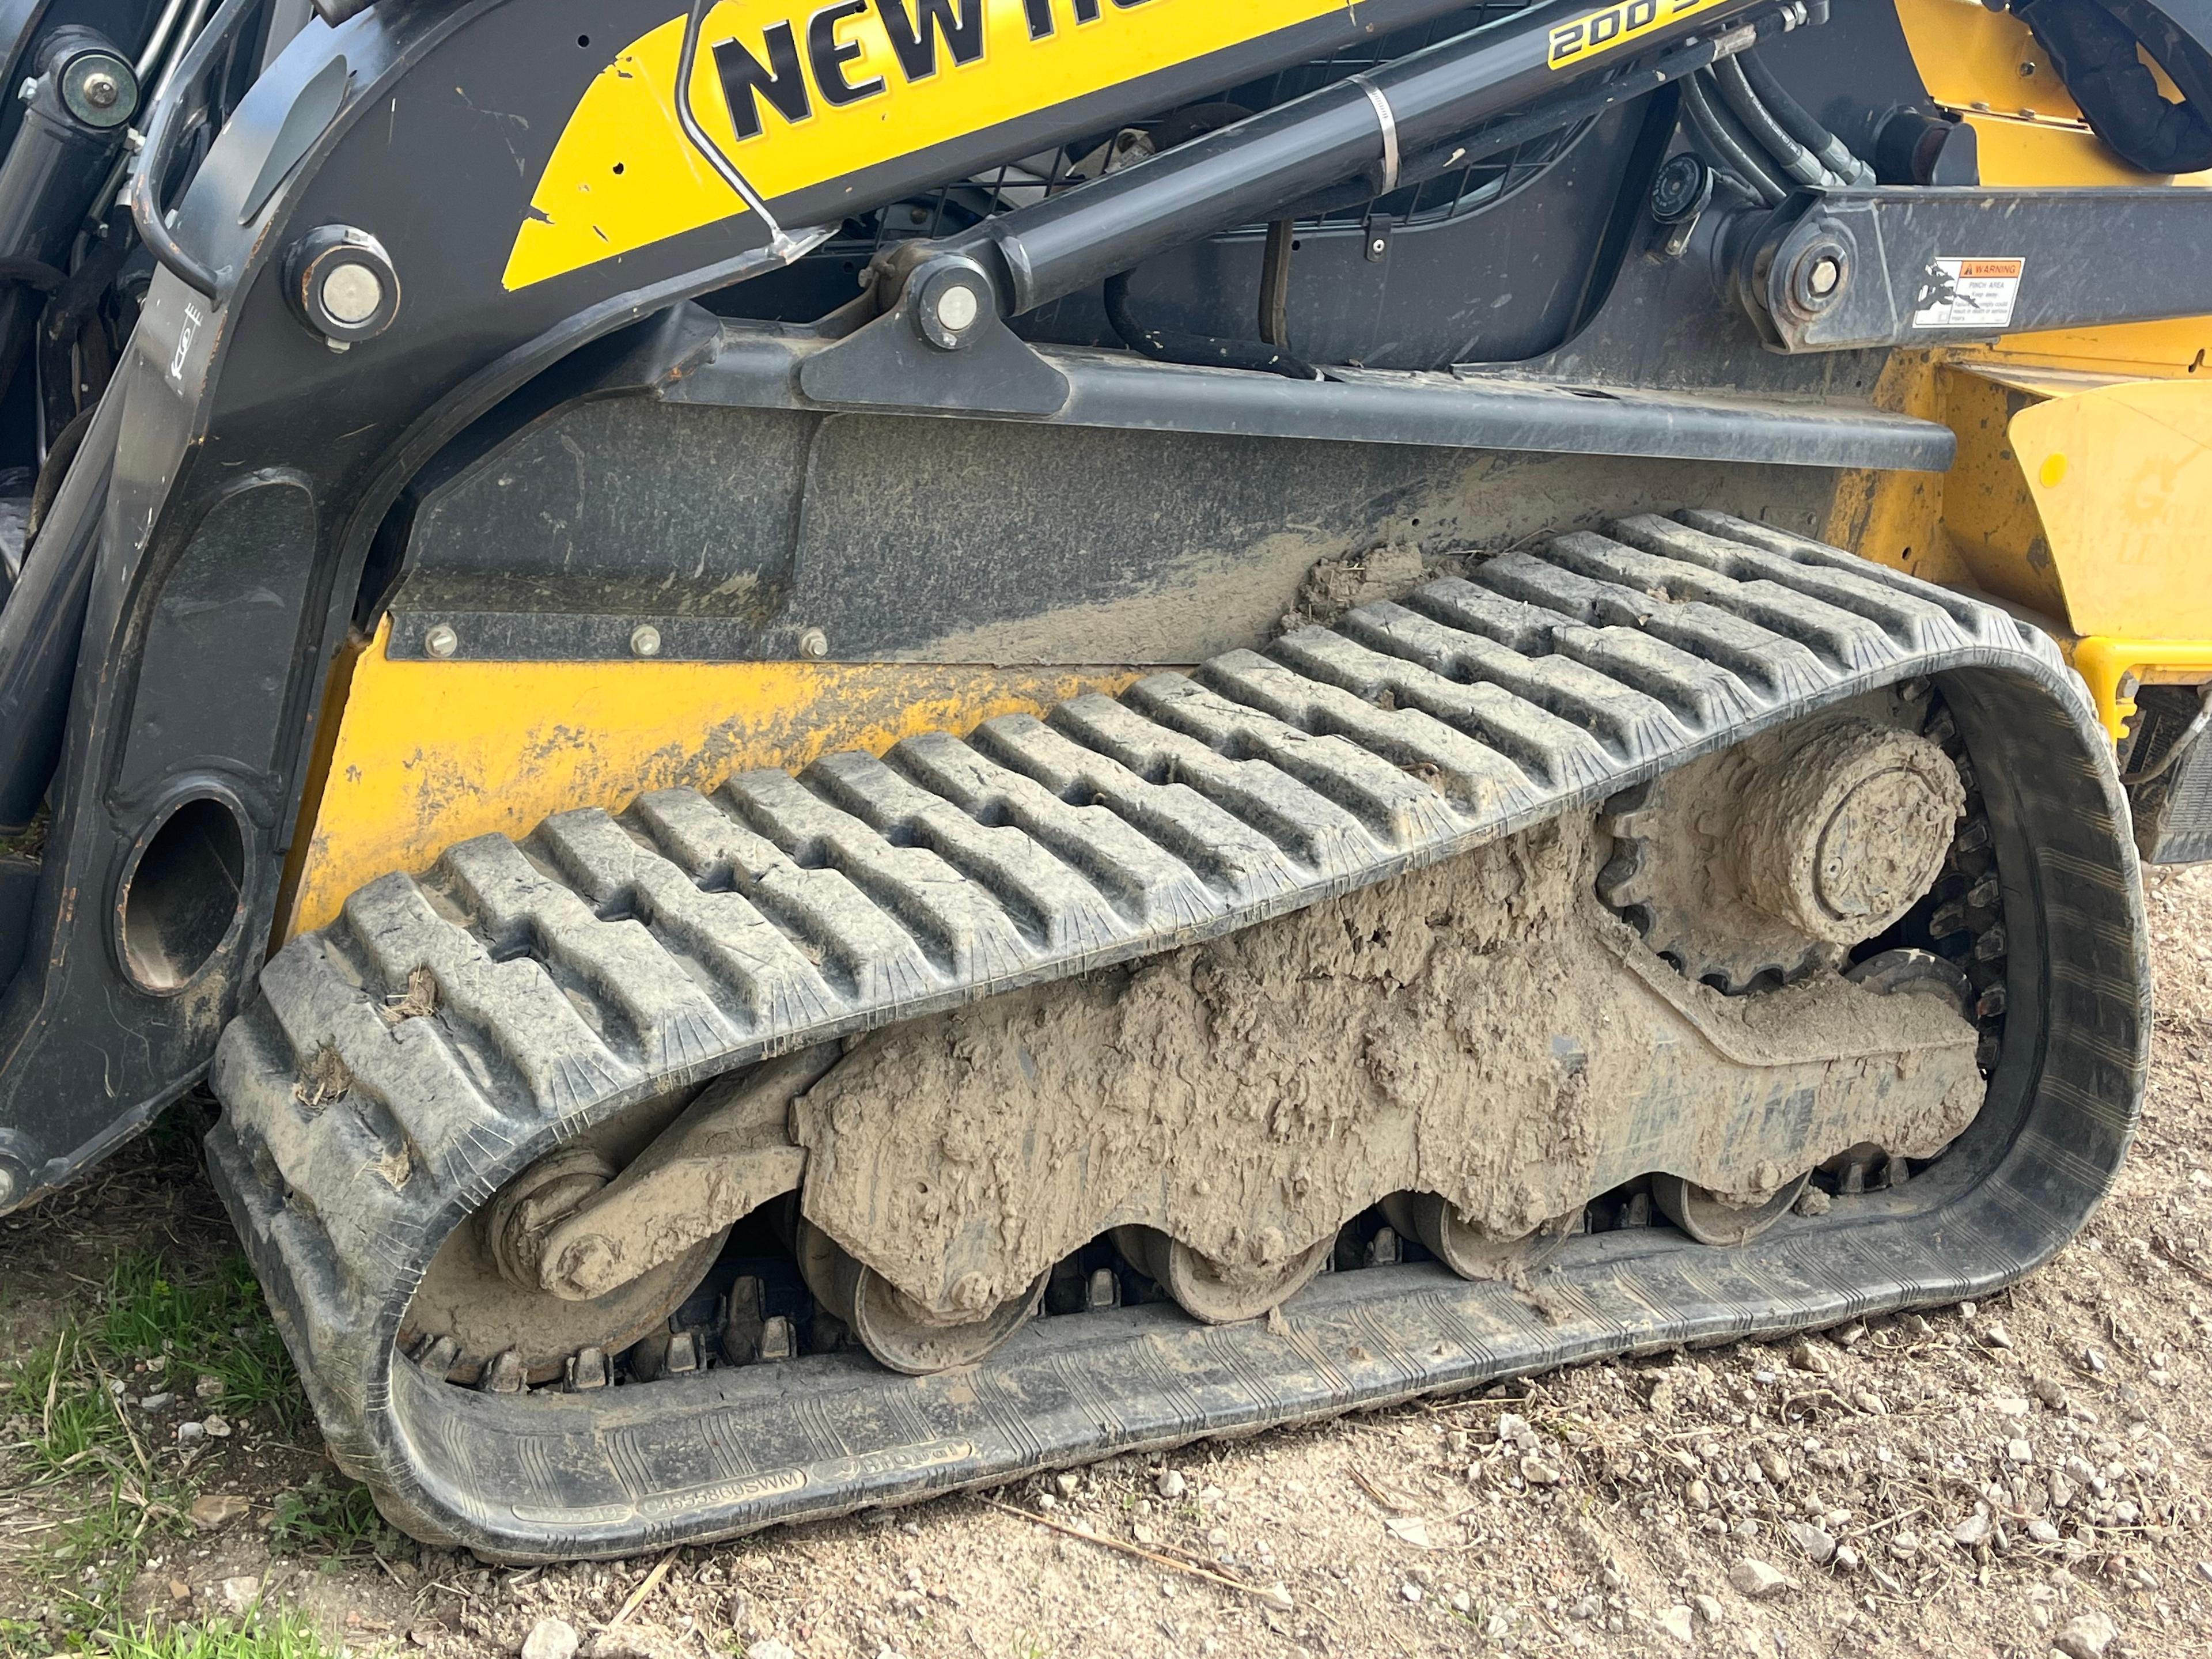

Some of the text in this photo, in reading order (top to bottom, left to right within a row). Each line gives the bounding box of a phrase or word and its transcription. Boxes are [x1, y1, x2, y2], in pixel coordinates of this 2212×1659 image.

[1552, 0, 1657, 60] 200
[712, 0, 984, 141] NEW
[1975, 265, 2016, 274] WARNING
[643, 1471, 798, 1515] C4555860SWM
